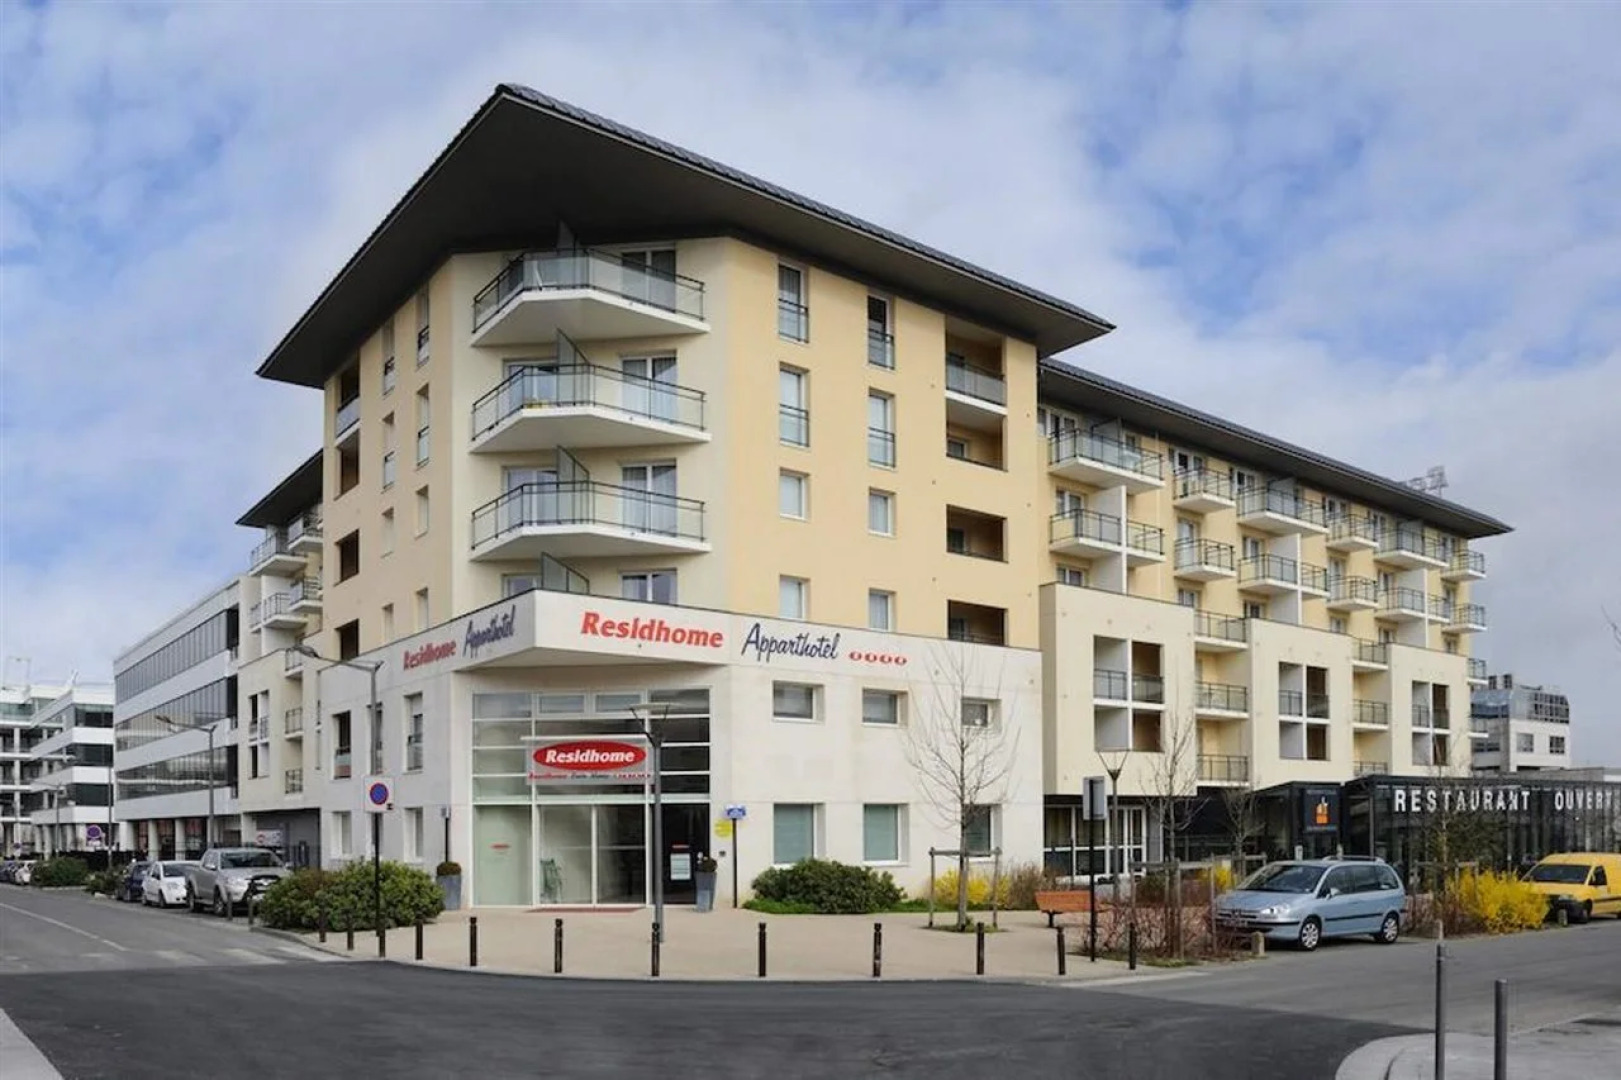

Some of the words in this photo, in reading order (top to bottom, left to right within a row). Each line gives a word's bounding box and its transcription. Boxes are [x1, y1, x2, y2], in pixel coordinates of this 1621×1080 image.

[580, 611, 723, 648] Residhome
[741, 622, 841, 663] Apparthotel
[403, 639, 457, 671] Residhome
[545, 748, 635, 763] Residhome
[1394, 789, 1531, 812] RESTAURANT
[1554, 790, 1612, 810] OUVERT
